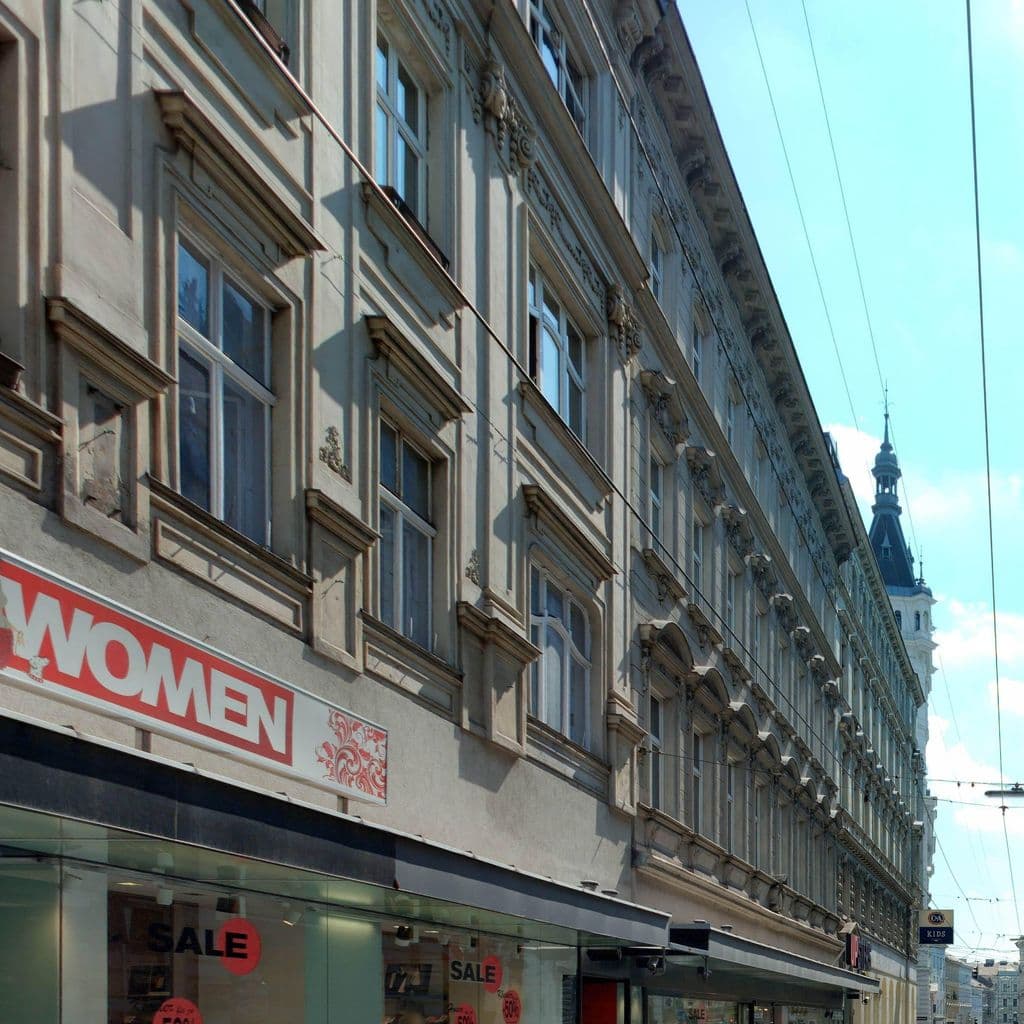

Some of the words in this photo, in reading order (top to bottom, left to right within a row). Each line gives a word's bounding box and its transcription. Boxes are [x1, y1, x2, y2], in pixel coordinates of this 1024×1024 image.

[0, 574, 287, 755] WOMEN
[148, 922, 249, 959] SALE
[926, 930, 946, 938] KIDS
[450, 960, 496, 983] SALE
